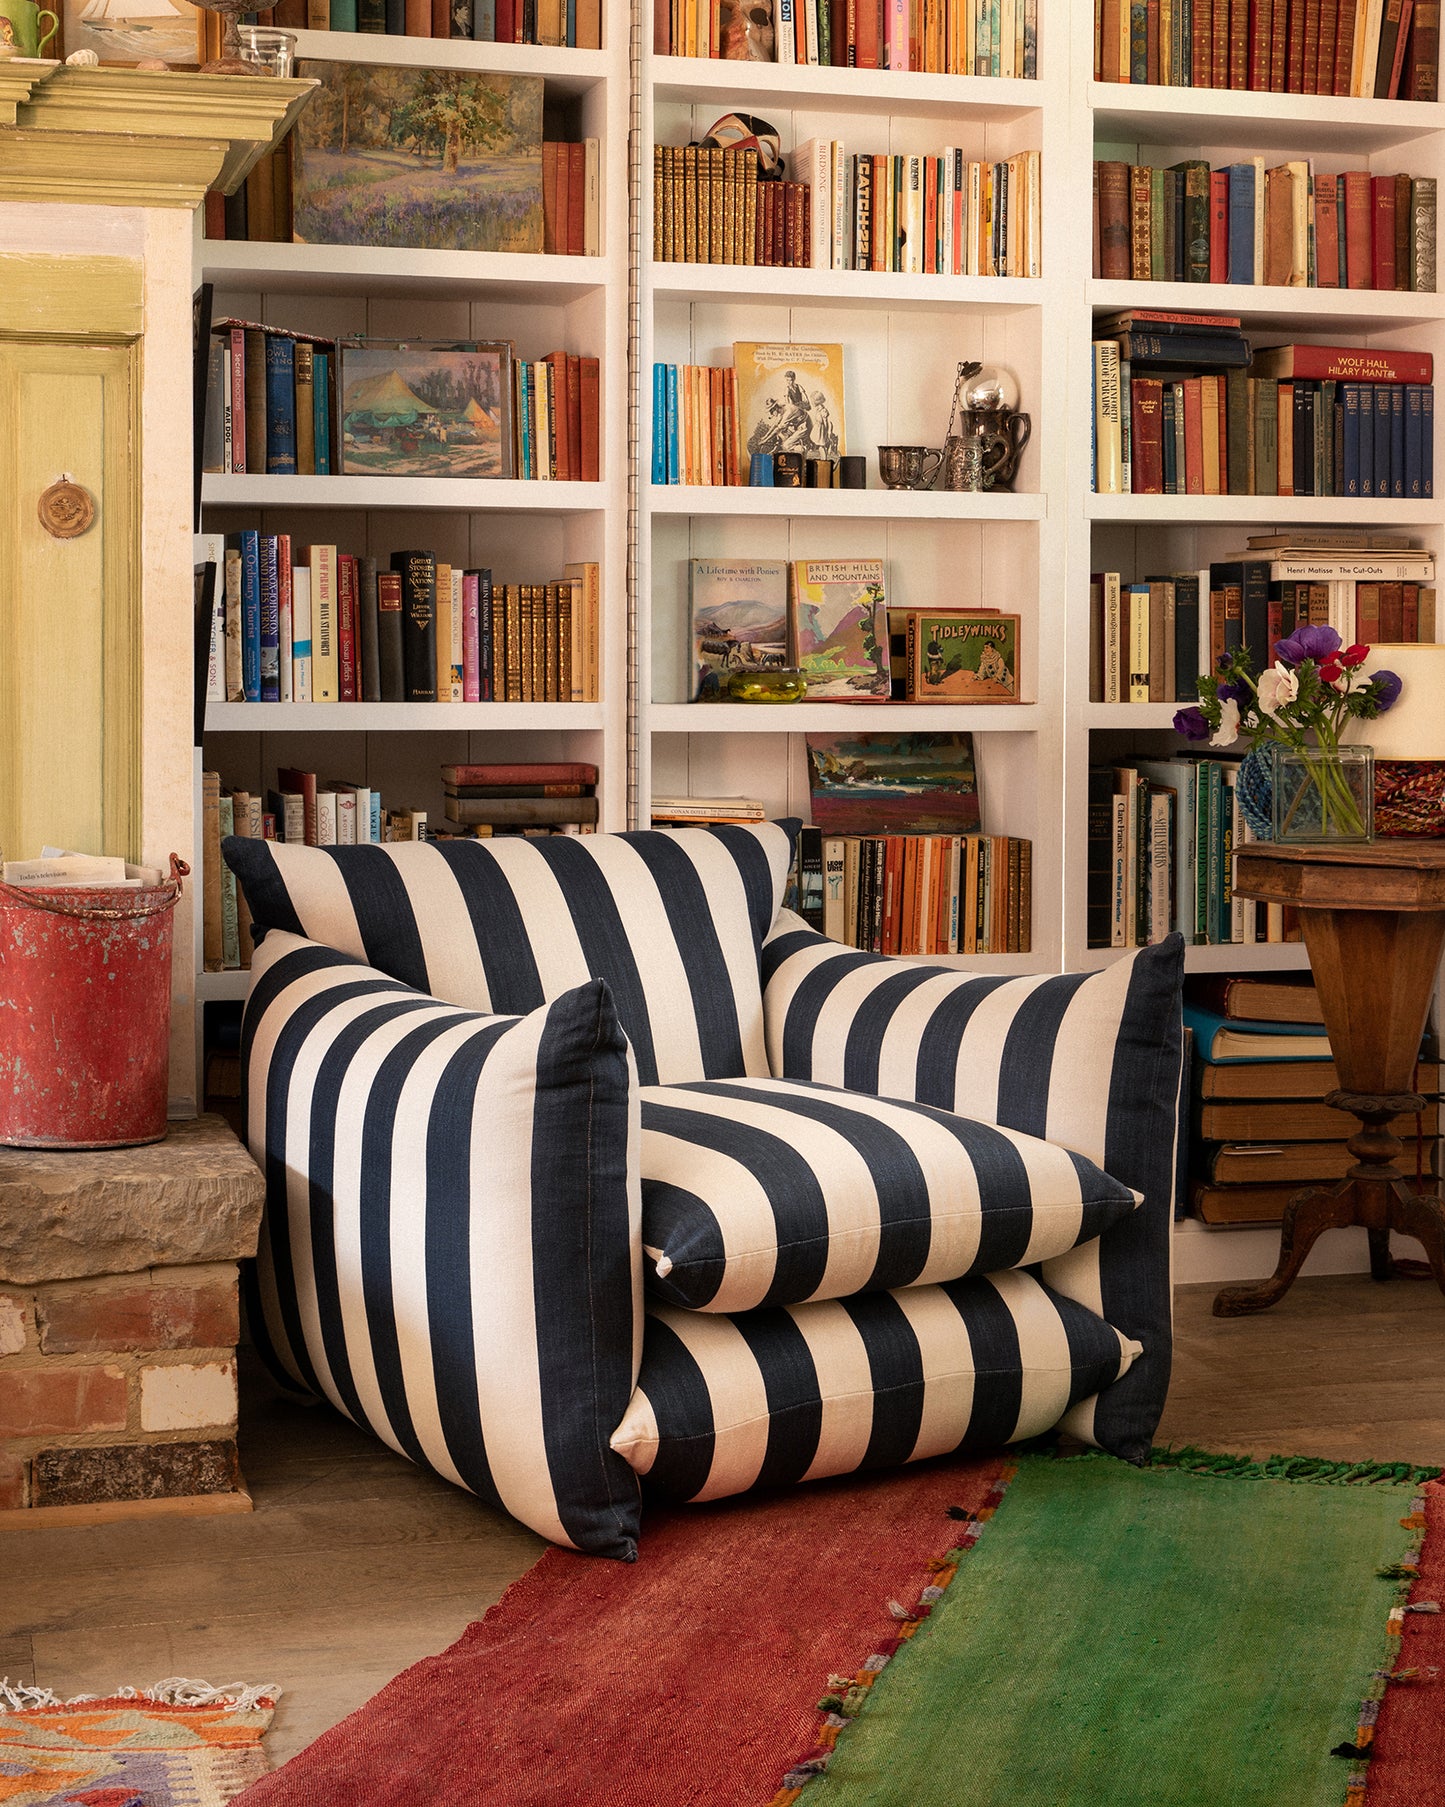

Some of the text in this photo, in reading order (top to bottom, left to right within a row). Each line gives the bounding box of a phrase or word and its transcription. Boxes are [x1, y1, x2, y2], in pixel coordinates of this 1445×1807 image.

[818, 145, 826, 192] BIRDSONG
[1328, 367, 1397, 378] HILARY MANTEL
[1338, 357, 1388, 368] WOLF HALL
[1101, 347, 1110, 417] BIRD OF PARADISE
[1110, 347, 1118, 423] DIANA STAINFORTH
[246, 536, 256, 552] No
[260, 539, 269, 575] BEYOND
[269, 539, 277, 564] ROBIN
[245, 555, 257, 600] Ordinary
[340, 562, 351, 595] Embracing
[706, 566, 738, 574] Lifetime
[832, 573, 880, 581] MOUNTAINS
[248, 604, 258, 639] Tourist
[260, 606, 269, 635] VERNE
[342, 596, 352, 630] Uncertainty
[930, 624, 1006, 642] TIDLEYWINKS
[1109, 613, 1117, 646] Monsignor
[343, 660, 352, 682] Jeffers
[1116, 803, 1125, 824] Clare
[1116, 825, 1125, 852] Francis
[1152, 818, 1167, 868] SHELL SEEKERS
[1211, 770, 1219, 895] The Complete Indoor Gardener
[1224, 830, 1232, 851] Cape
[1225, 875, 1232, 883] to
[226, 914, 235, 940] DIARY
